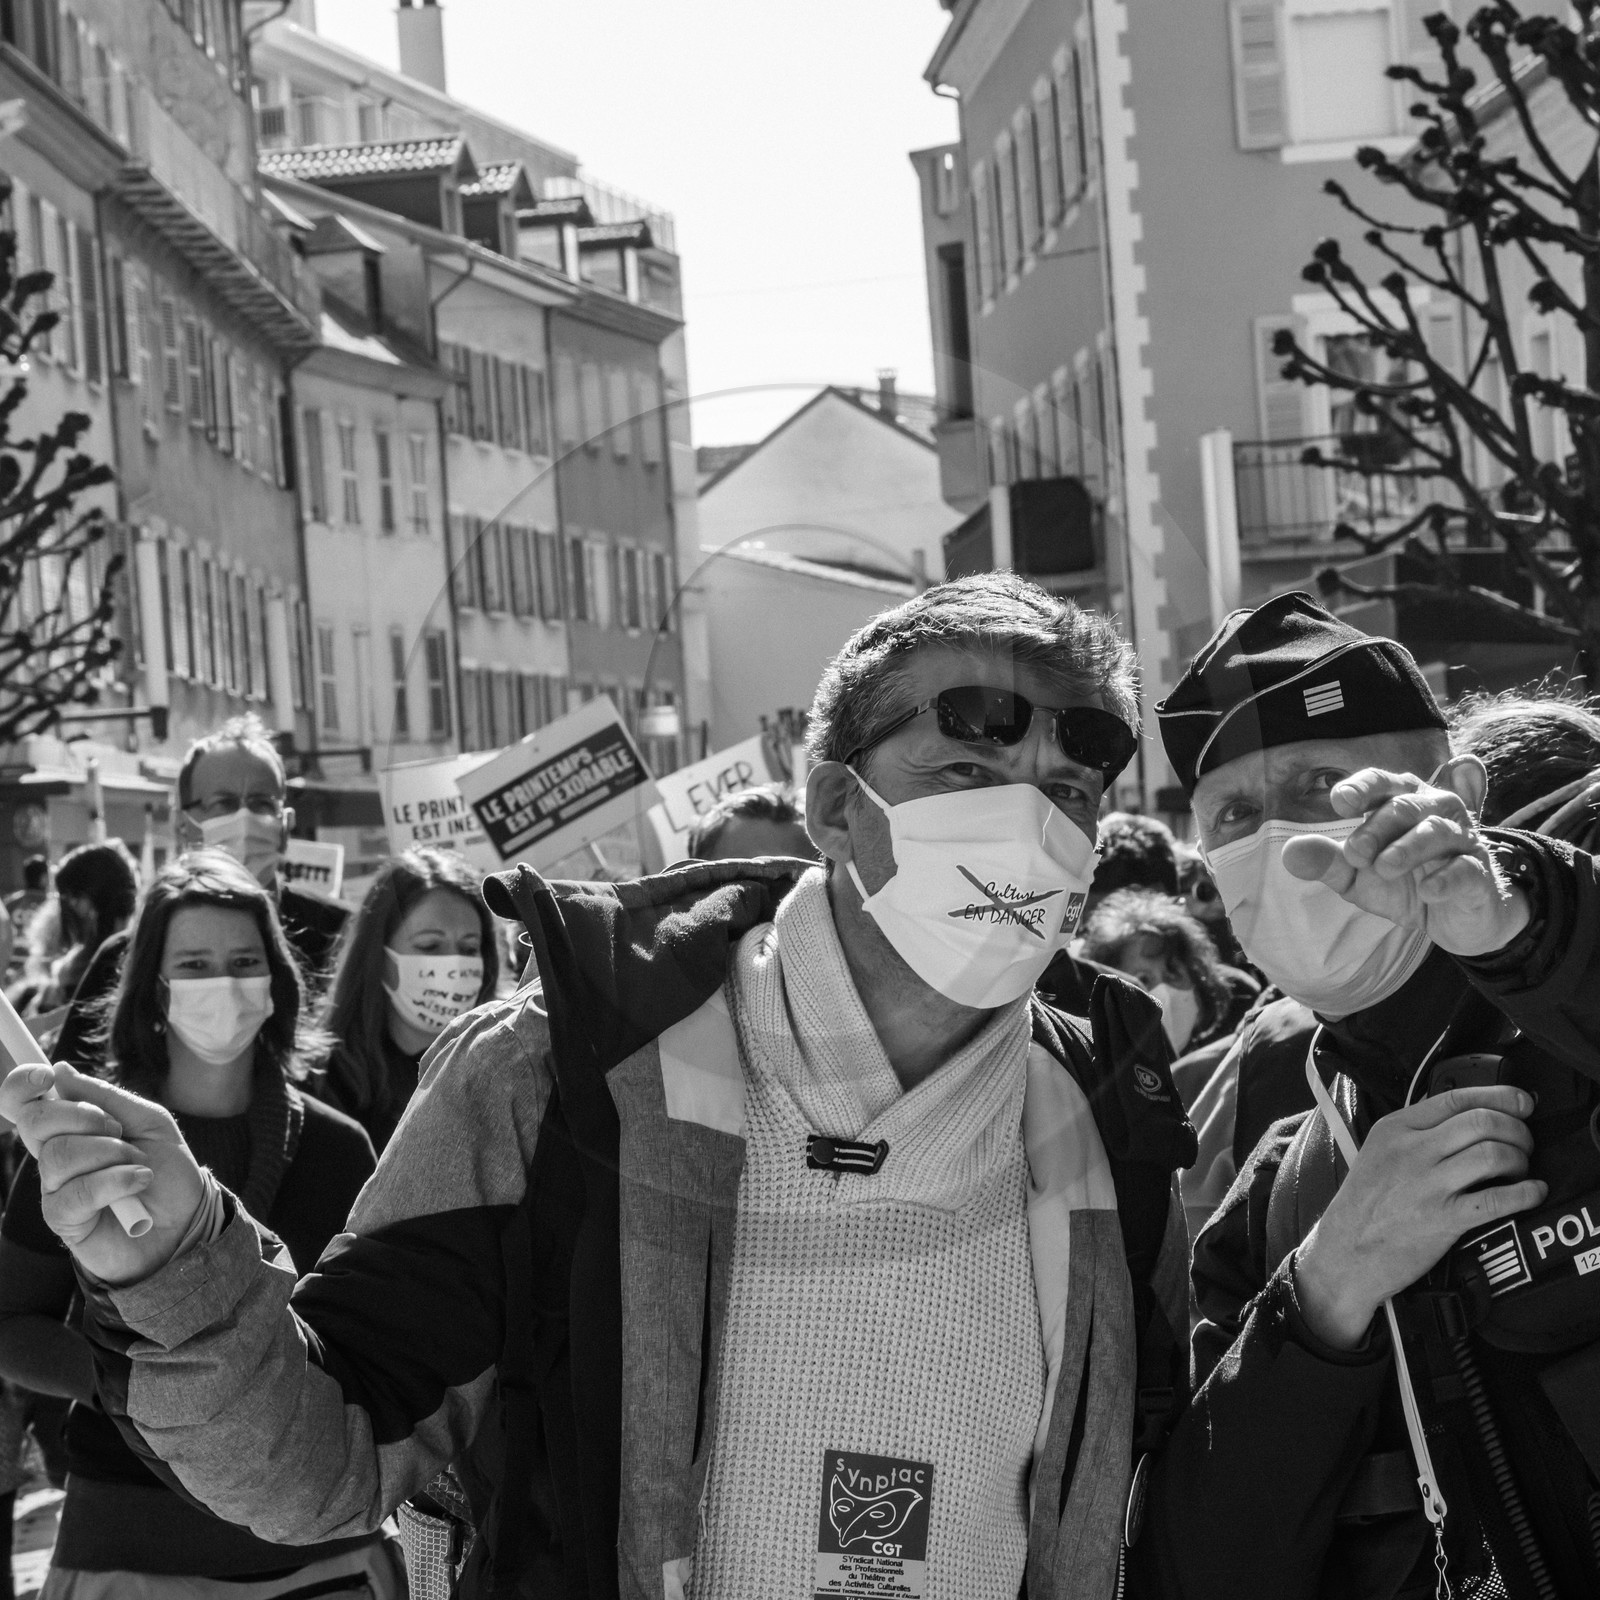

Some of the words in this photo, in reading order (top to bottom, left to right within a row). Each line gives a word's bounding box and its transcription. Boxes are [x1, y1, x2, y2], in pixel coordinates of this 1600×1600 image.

[480, 798, 506, 824] LE
[502, 747, 593, 813] PRINTEMPS
[505, 804, 536, 834] EST
[537, 748, 634, 815] INEXORABLE
[393, 804, 413, 825] LE
[412, 822, 440, 841] EST
[984, 881, 1036, 901] Culture
[964, 903, 985, 921] EN
[990, 906, 1046, 927] DANGER
[1066, 902, 1082, 922] cgt
[1580, 1252, 1600, 1270] 12
[872, 1541, 903, 1557] CGT
[842, 1555, 874, 1565] SYndicat
[876, 1558, 903, 1567] National
[855, 1564, 904, 1576] Professionnels
[828, 1579, 841, 1587] des
[845, 1580, 875, 1589] Activités
[877, 1582, 911, 1592] Culturelles
[848, 1572, 857, 1580] du
[860, 1573, 886, 1582] Théâtre
